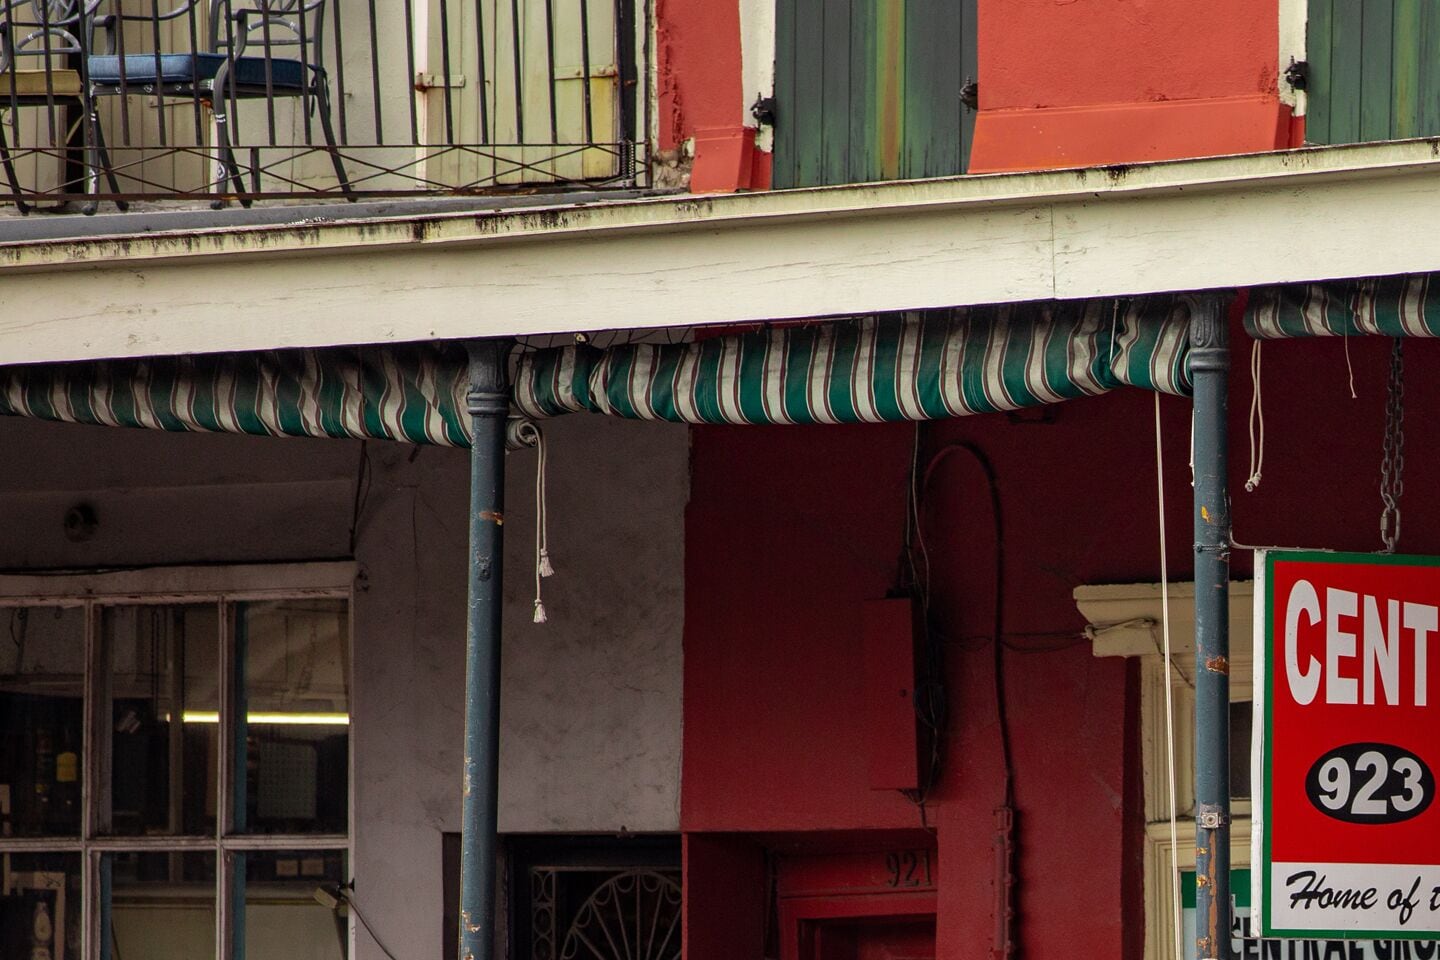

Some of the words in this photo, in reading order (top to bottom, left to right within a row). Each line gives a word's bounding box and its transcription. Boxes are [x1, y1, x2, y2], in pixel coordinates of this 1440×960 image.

[1317, 750, 1425, 815] 923
[886, 848, 932, 888] 921
[1285, 870, 1379, 910] Home
[1386, 875, 1421, 926] of
